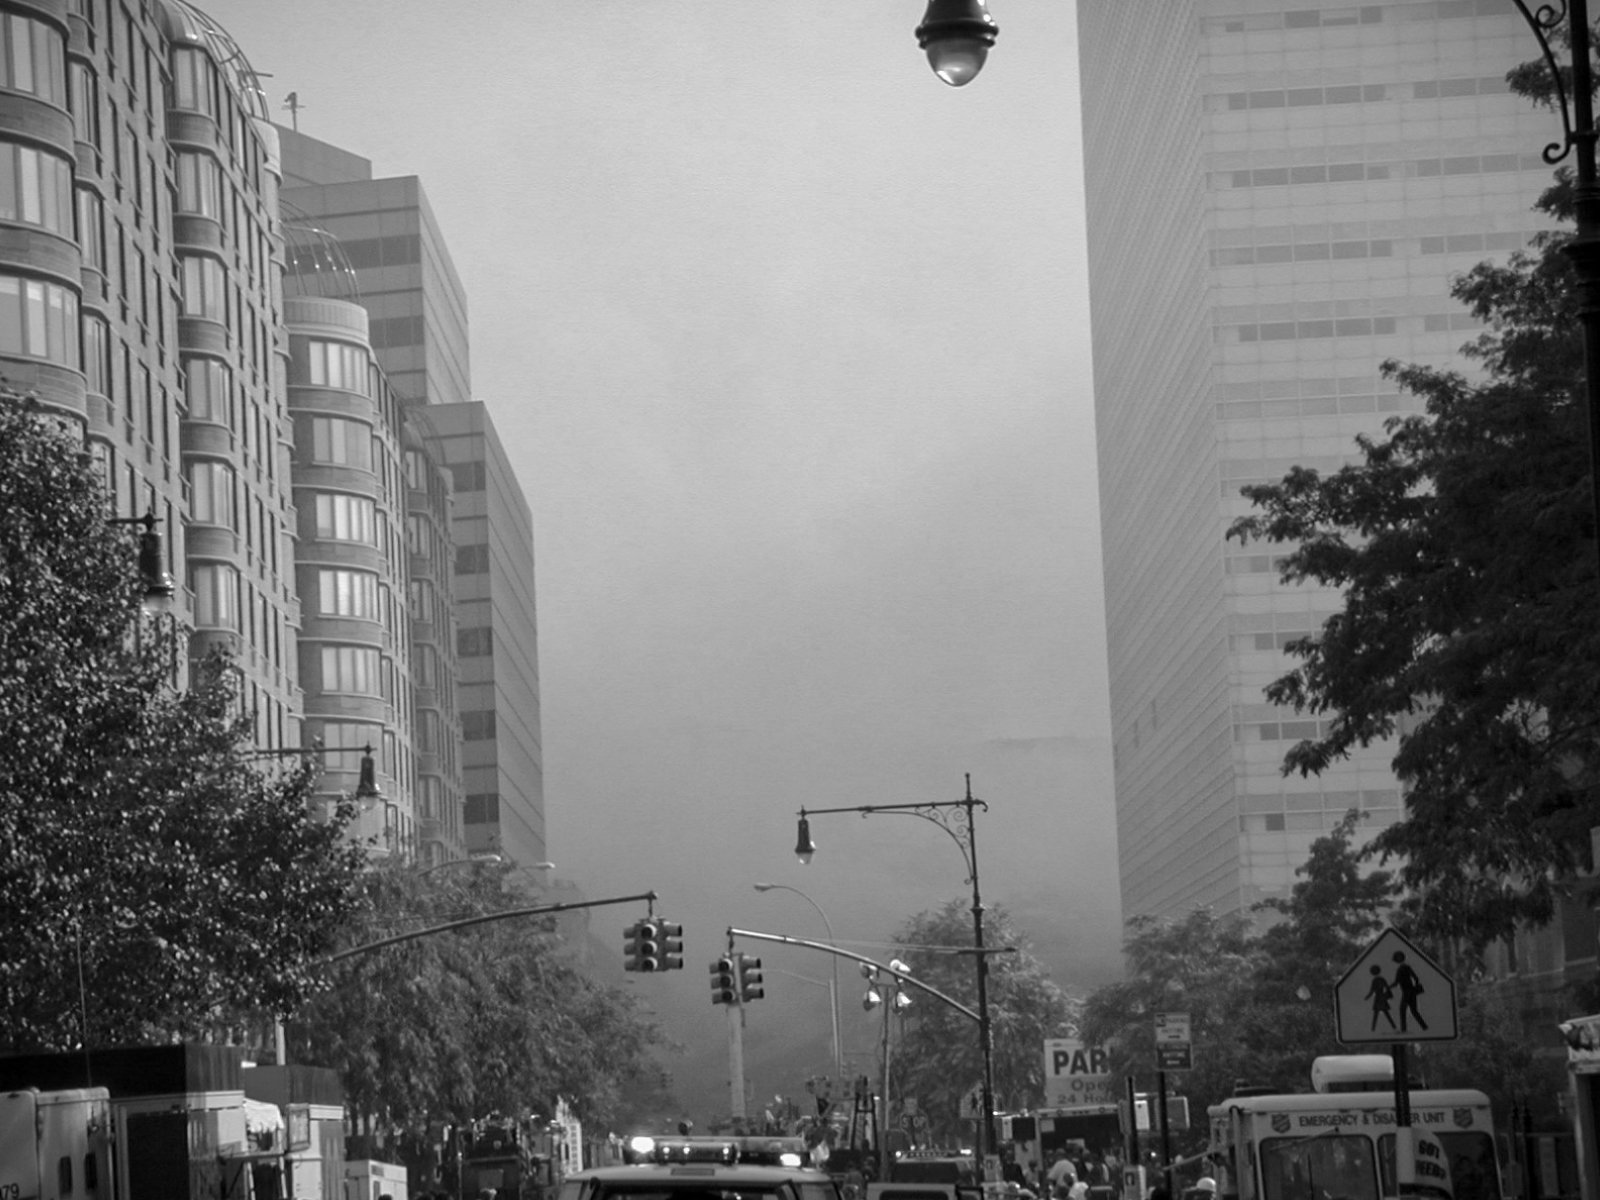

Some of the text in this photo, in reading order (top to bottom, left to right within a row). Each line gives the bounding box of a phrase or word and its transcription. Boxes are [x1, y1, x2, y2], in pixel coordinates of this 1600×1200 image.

[1299, 1111, 1445, 1127] EMERGENCY & DISAER UNIT
